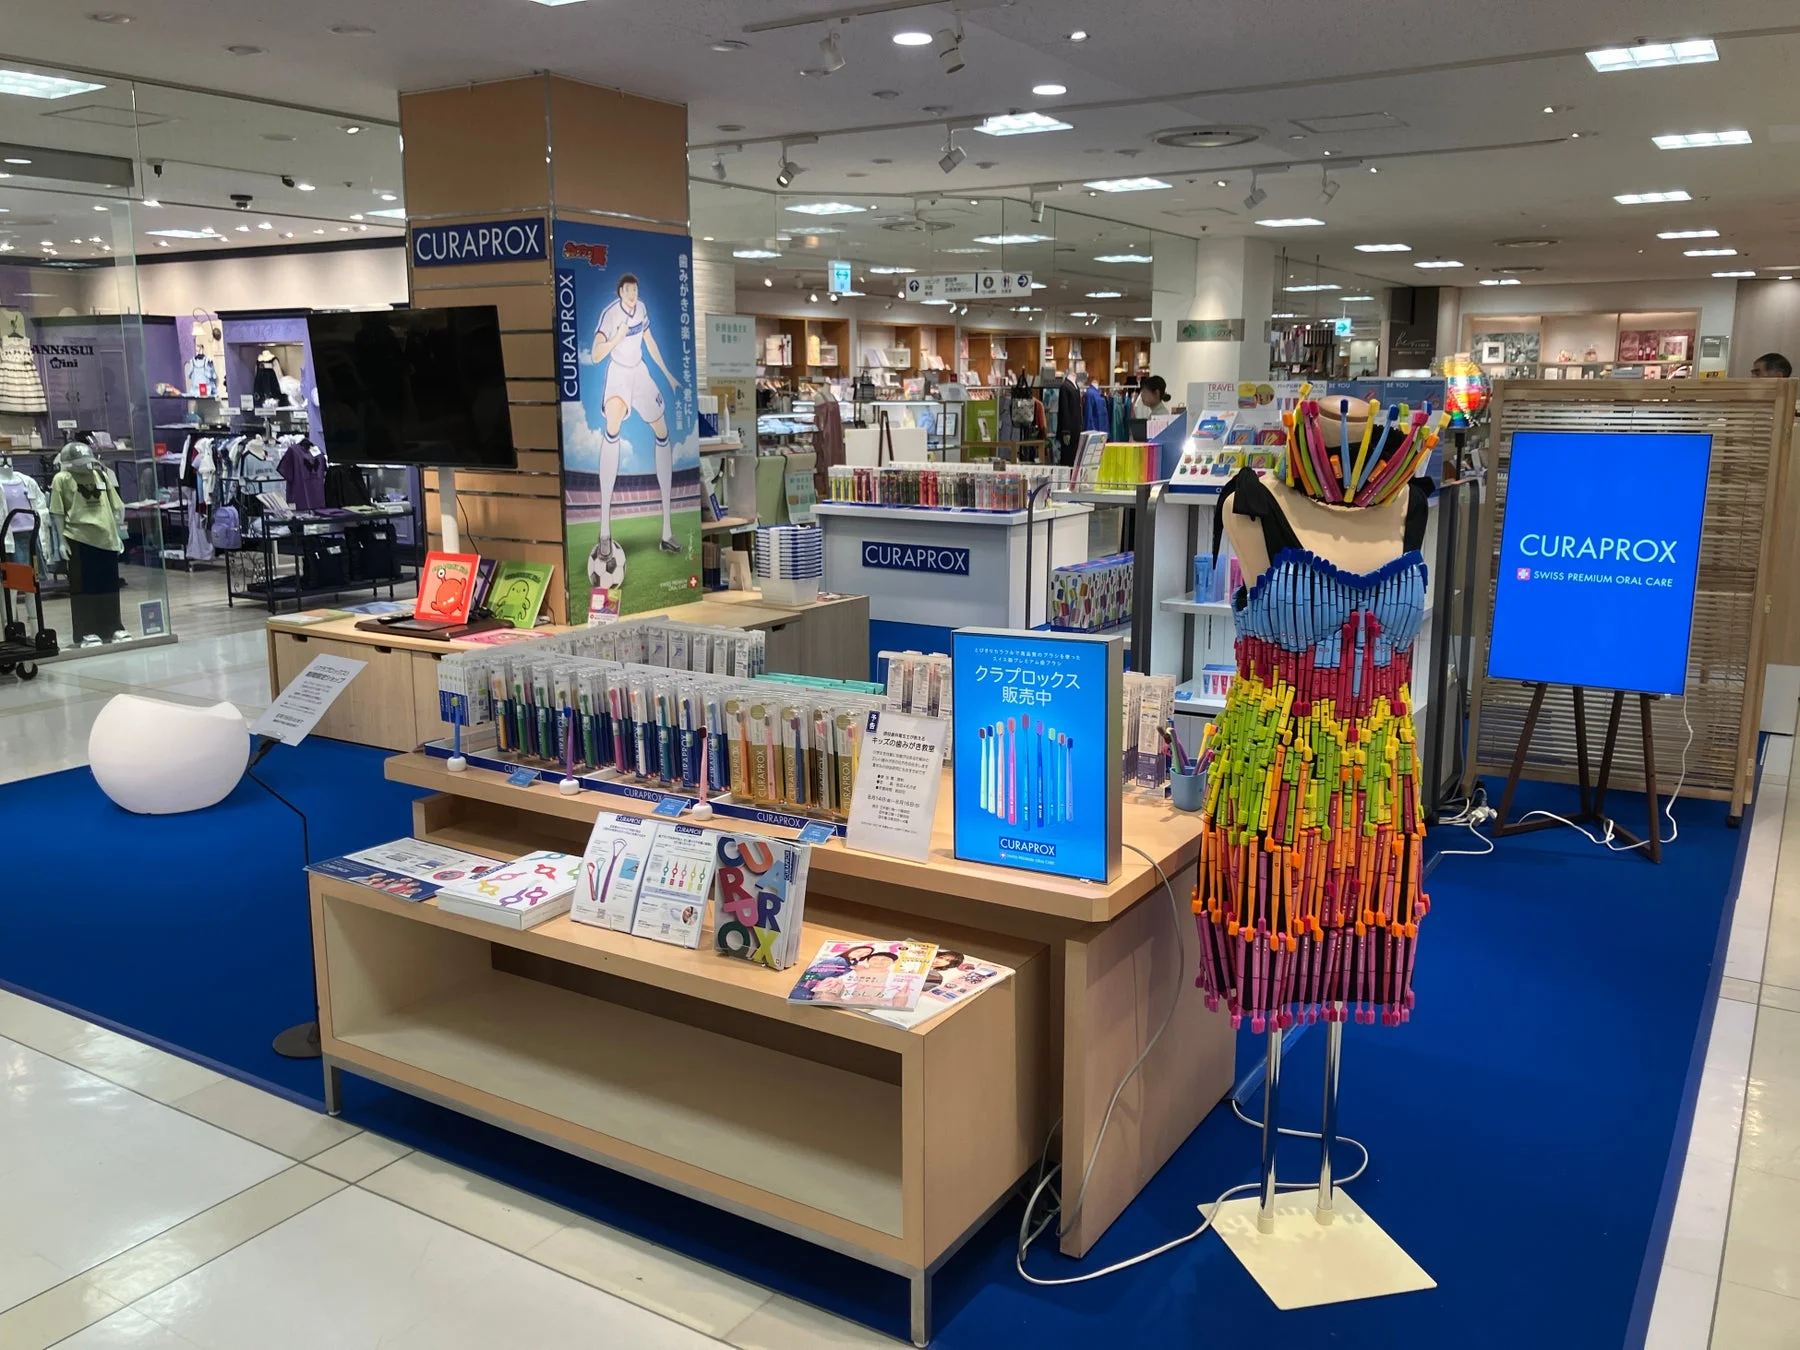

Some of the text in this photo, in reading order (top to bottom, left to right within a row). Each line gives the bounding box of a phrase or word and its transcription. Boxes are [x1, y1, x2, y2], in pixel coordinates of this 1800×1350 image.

[416, 225, 540, 261] CURAPROX
[560, 275, 578, 398] CURAPROX
[1208, 383, 1235, 392] TRAVEL
[1208, 392, 1222, 401] SET
[864, 544, 967, 572] CURAPROX
[1519, 533, 1678, 564] CURAPROX
[1533, 570, 1673, 588] SWISS PREMIUM ORAL CARE
[975, 665, 1080, 690] クラプロックス
[1002, 686, 1052, 708] 販売中
[869, 713, 877, 730] 予告
[872, 737, 935, 753] キッズの歯みがき教室
[757, 750, 765, 797] CURAPROX
[787, 753, 796, 801] CURAPROX
[623, 787, 662, 803] CURAPROX
[757, 812, 801, 828] CURAPROX
[1000, 838, 1055, 856] CURAPROX
